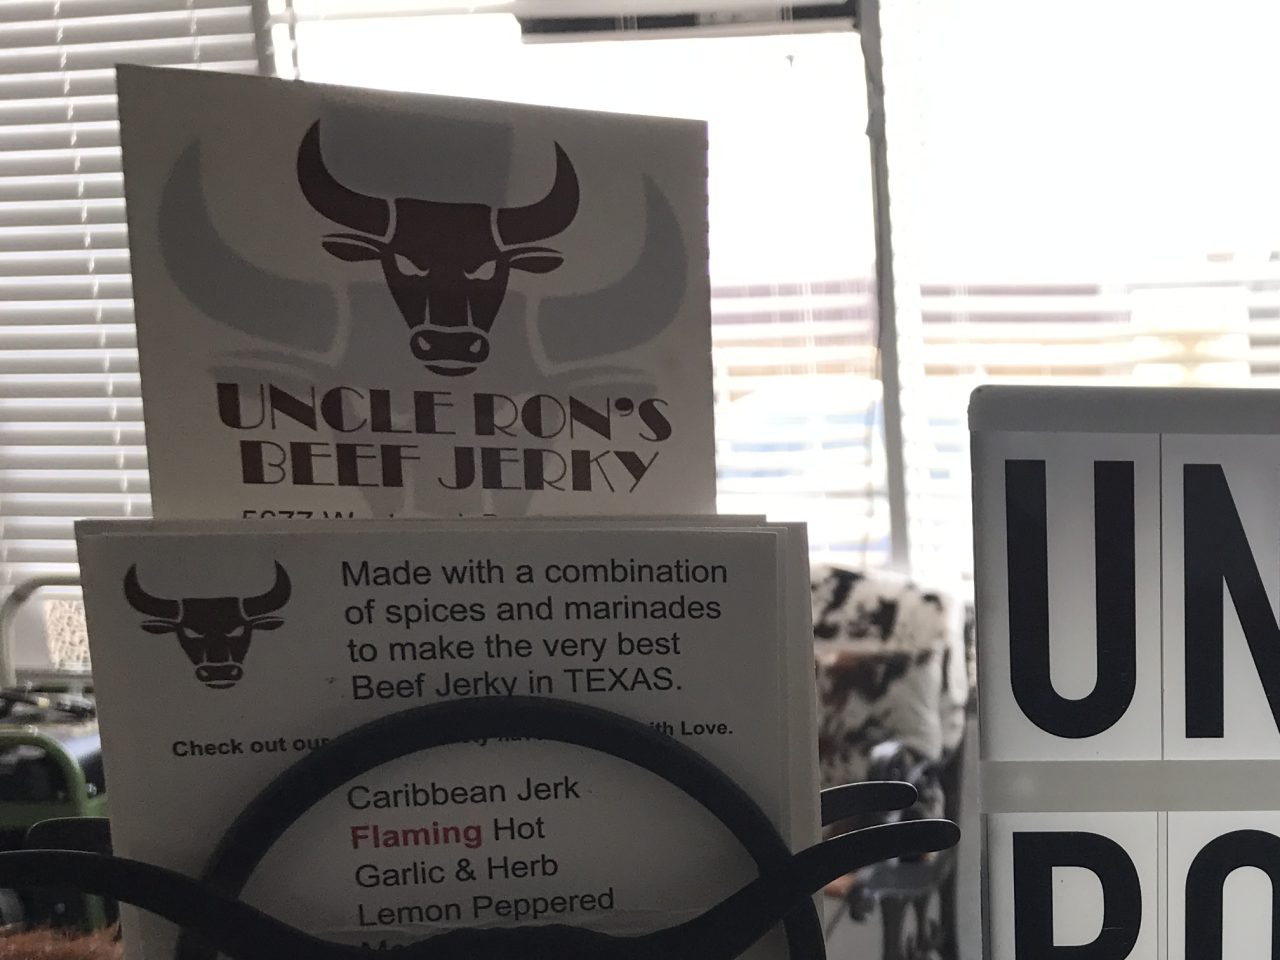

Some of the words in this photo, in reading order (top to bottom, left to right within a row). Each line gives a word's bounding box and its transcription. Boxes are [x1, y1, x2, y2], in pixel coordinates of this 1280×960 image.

[216, 382, 456, 435] UNCLE
[473, 392, 672, 442] RON'S
[240, 440, 421, 487] BEEF
[438, 446, 659, 493] JERKY
[342, 560, 432, 587] Made
[441, 558, 504, 584] with
[515, 564, 534, 583] a
[545, 558, 728, 583] combination
[345, 599, 375, 625] of
[385, 598, 486, 629] spices
[496, 596, 553, 620] and
[565, 595, 722, 620] marinades
[347, 638, 378, 663] to
[389, 635, 475, 661] make
[485, 634, 533, 658] the
[543, 636, 607, 662] very
[617, 632, 681, 656] best
[352, 672, 426, 700] Beef
[435, 671, 518, 698] Jerky
[529, 670, 553, 694] in
[564, 666, 682, 693] TEXAS.
[172, 738, 243, 757] Check
[251, 737, 287, 753] out
[681, 720, 733, 736] Love.
[347, 782, 506, 810] Caribbean
[517, 776, 581, 802] Jerk
[350, 821, 482, 850] Flaming
[493, 816, 546, 842] Hot
[355, 861, 446, 888] Garlic
[455, 858, 477, 882] &
[488, 854, 559, 880] Herb
[358, 899, 462, 927] Lemon
[472, 886, 615, 921] Peppered
